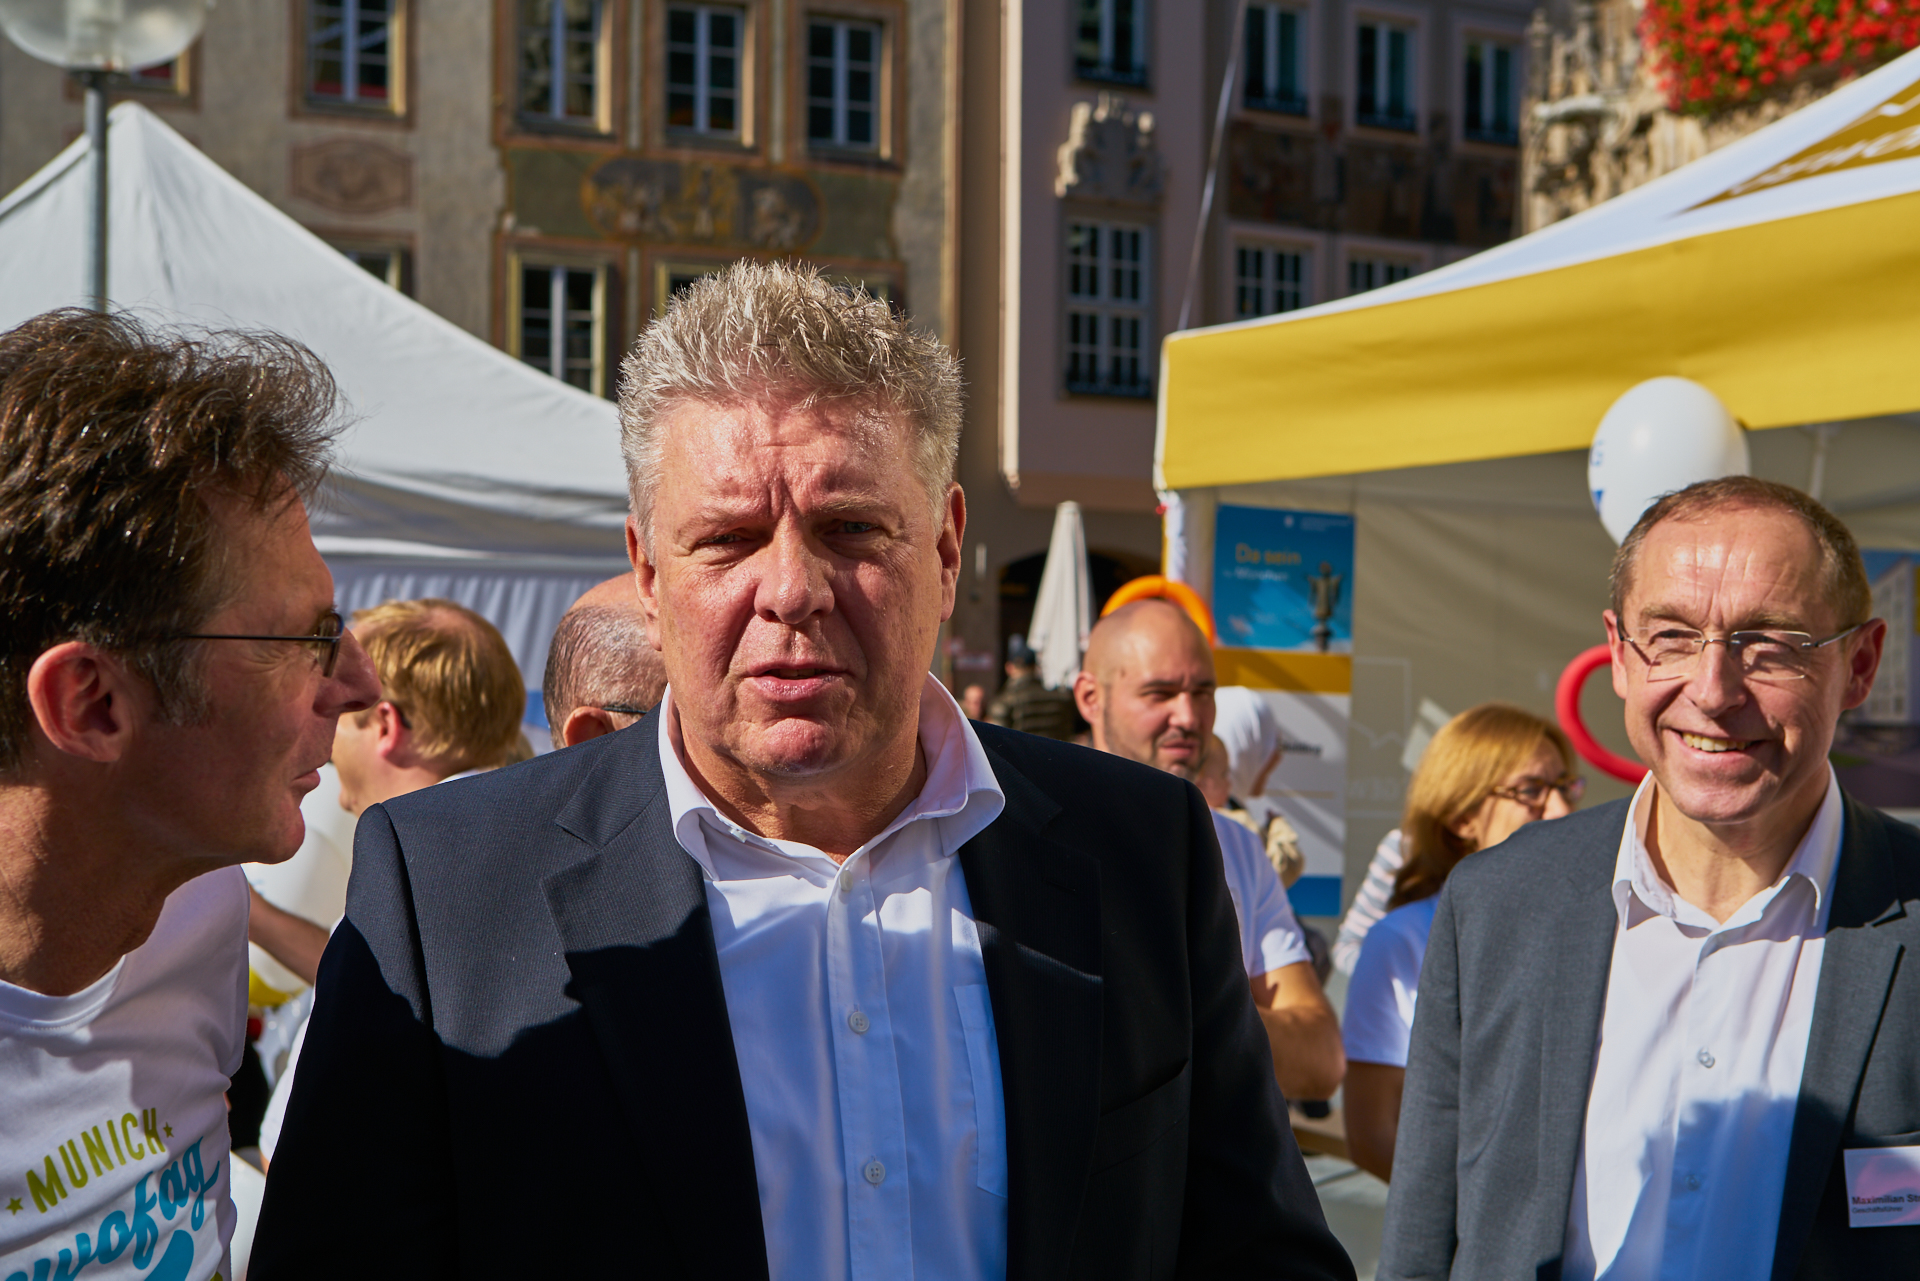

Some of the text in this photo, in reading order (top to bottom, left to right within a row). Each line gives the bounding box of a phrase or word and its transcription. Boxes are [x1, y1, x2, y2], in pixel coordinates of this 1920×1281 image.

[1235, 542, 1302, 565] Da sein
[25, 1107, 166, 1214] MUNICH
[1852, 1194, 1904, 1204] Maximilian
